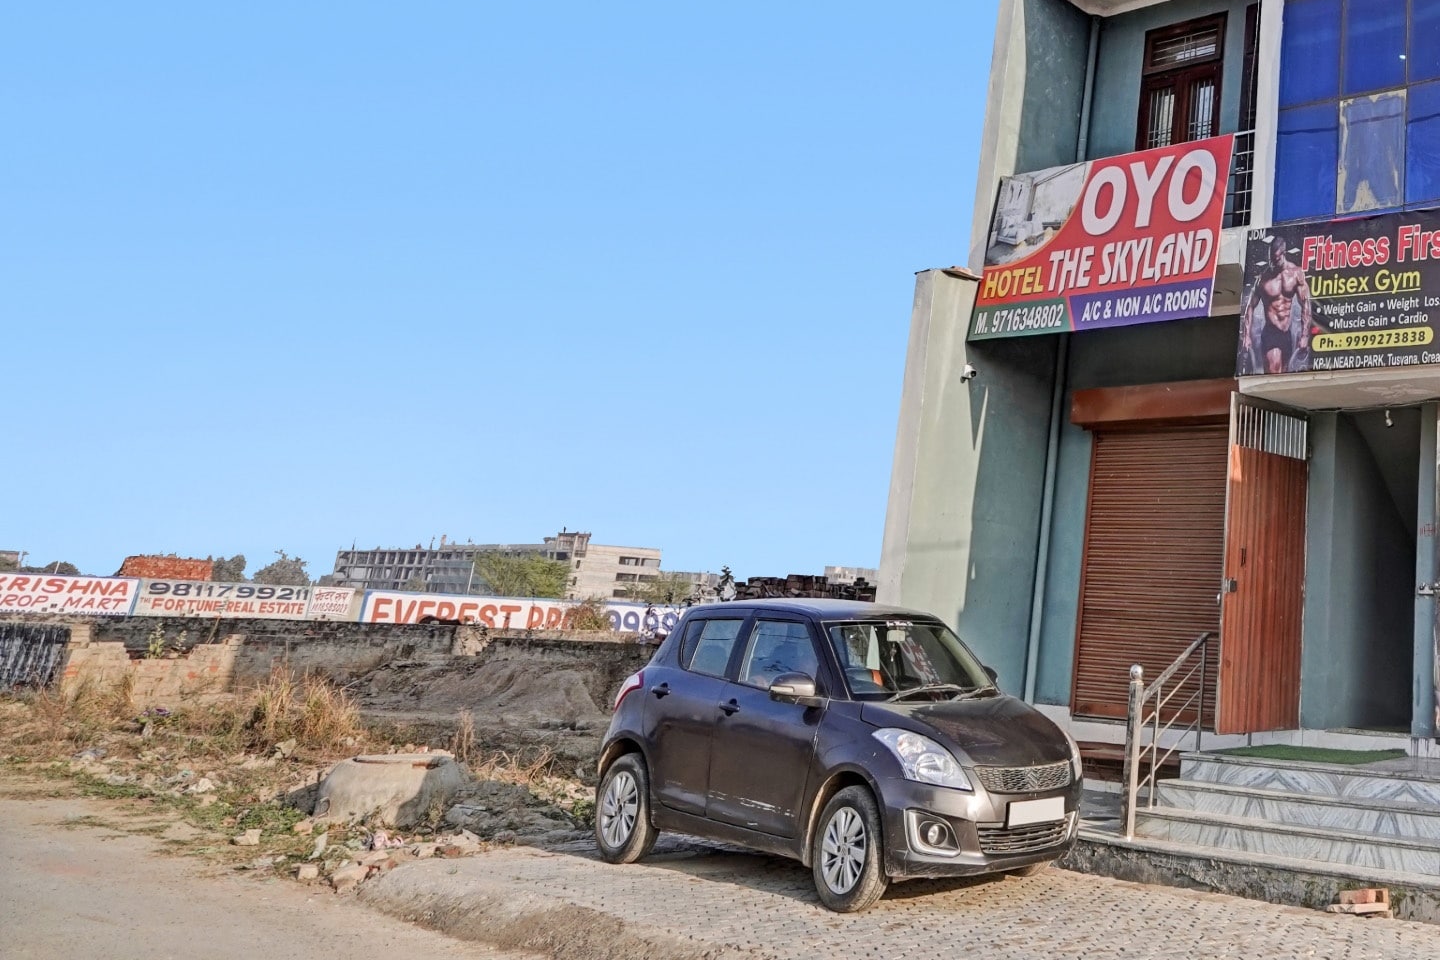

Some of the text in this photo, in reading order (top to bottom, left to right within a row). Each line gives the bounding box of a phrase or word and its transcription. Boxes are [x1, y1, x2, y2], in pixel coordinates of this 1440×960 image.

[1081, 148, 1217, 236] OYO
[983, 228, 1213, 300] HOTEL THE SKYLAND
[1301, 235, 1390, 272] Fitness
[1310, 269, 1421, 297] Unisex Gym
[1081, 287, 1208, 322] A/C & NON A/C ROOMS
[1323, 303, 1355, 316] Weight
[1356, 300, 1377, 312] Gain
[1386, 298, 1420, 311] Weight
[974, 304, 1064, 334] M. 9716348802
[1333, 311, 1428, 329] Muscle Gain Cardio
[1345, 330, 1426, 347] 9999273838
[1333, 356, 1355, 369] NEAR
[0, 593, 127, 610] ROP MART
[151, 597, 221, 612] FORTUNE
[224, 600, 255, 613] REAL
[258, 601, 305, 615] ESTATE
[371, 598, 522, 629] EVEREST
